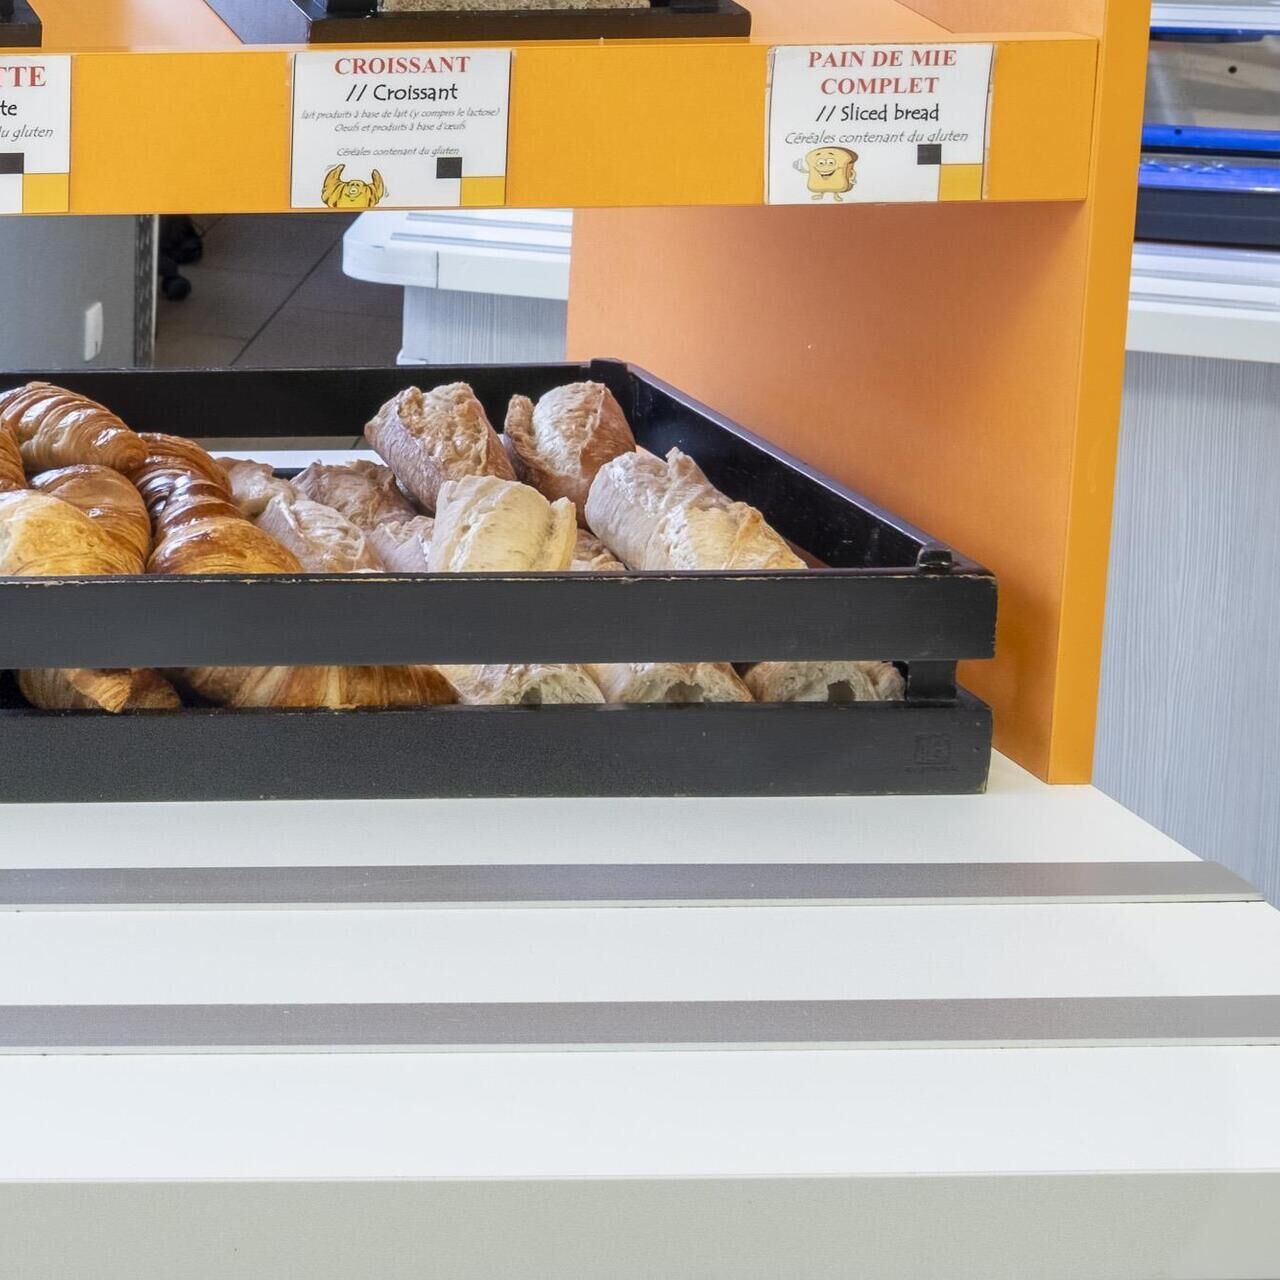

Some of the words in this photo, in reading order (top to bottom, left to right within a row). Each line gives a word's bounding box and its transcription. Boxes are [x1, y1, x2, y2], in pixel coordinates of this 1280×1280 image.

[335, 56, 470, 75] CROISSANT
[808, 50, 864, 68] PAIN
[872, 50, 903, 67] DE
[911, 49, 957, 67] MIE
[374, 83, 458, 101] Croissant
[821, 77, 940, 95] COMPLET
[841, 103, 887, 122] Sliced
[894, 103, 939, 122] bread
[12, 124, 54, 142] gluten
[785, 130, 836, 145] Céréales
[839, 130, 904, 144] contenant
[907, 129, 924, 142] du
[927, 128, 968, 144] gluten
